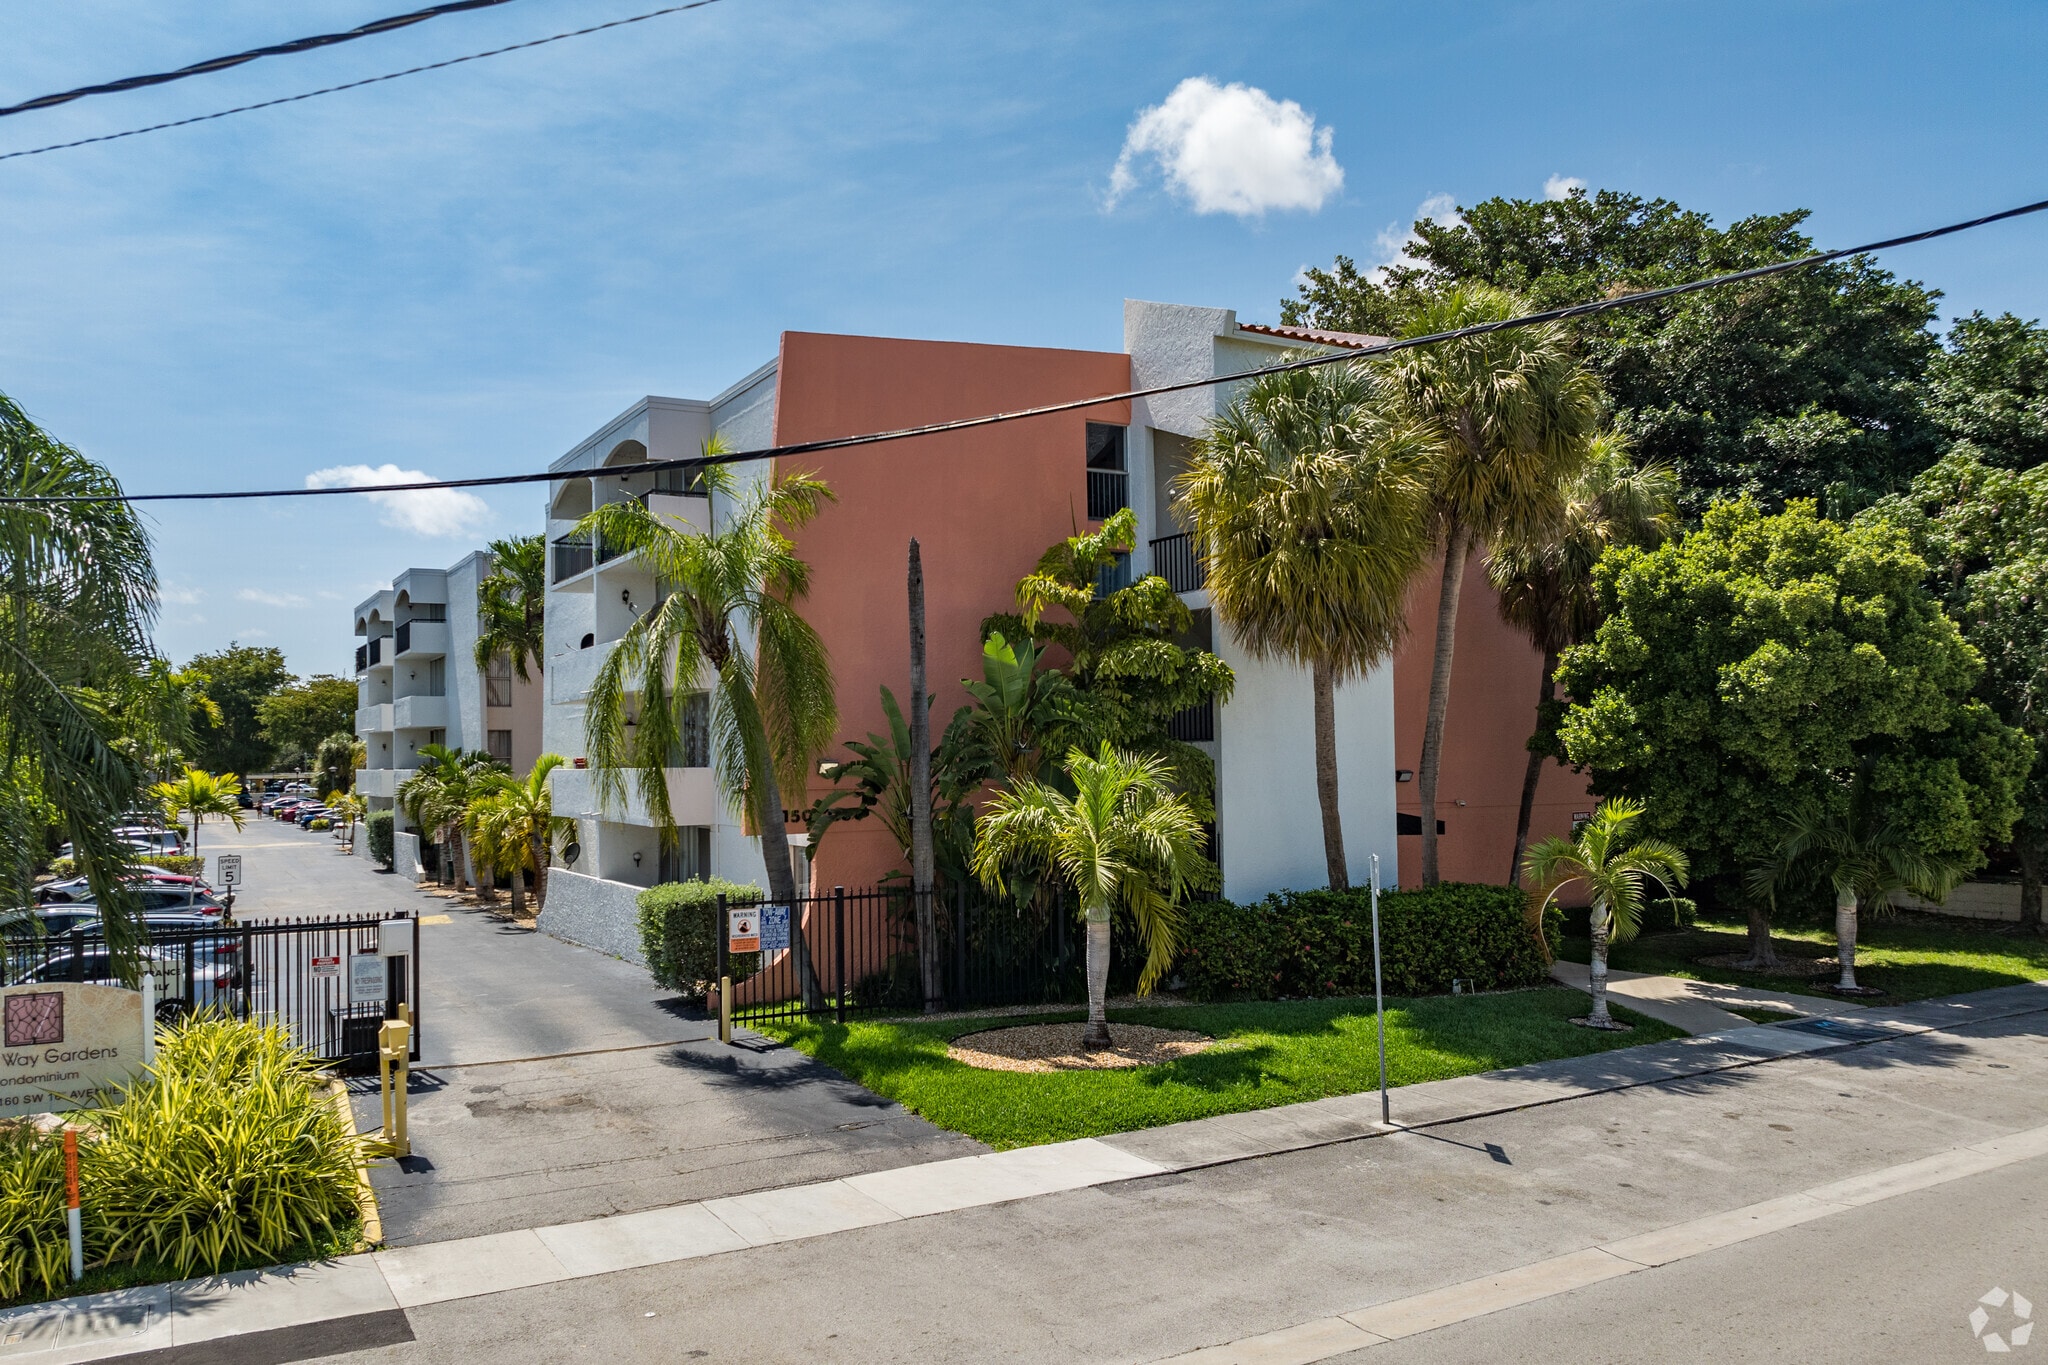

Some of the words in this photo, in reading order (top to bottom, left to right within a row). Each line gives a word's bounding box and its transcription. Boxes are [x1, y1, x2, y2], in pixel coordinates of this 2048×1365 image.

[225, 871, 234, 882] 5
[733, 911, 757, 919] WARNING
[2, 1052, 39, 1068] Way
[44, 1047, 118, 1063] Gardens
[0, 1071, 79, 1087] ondominium
[23, 1094, 43, 1104] SW
